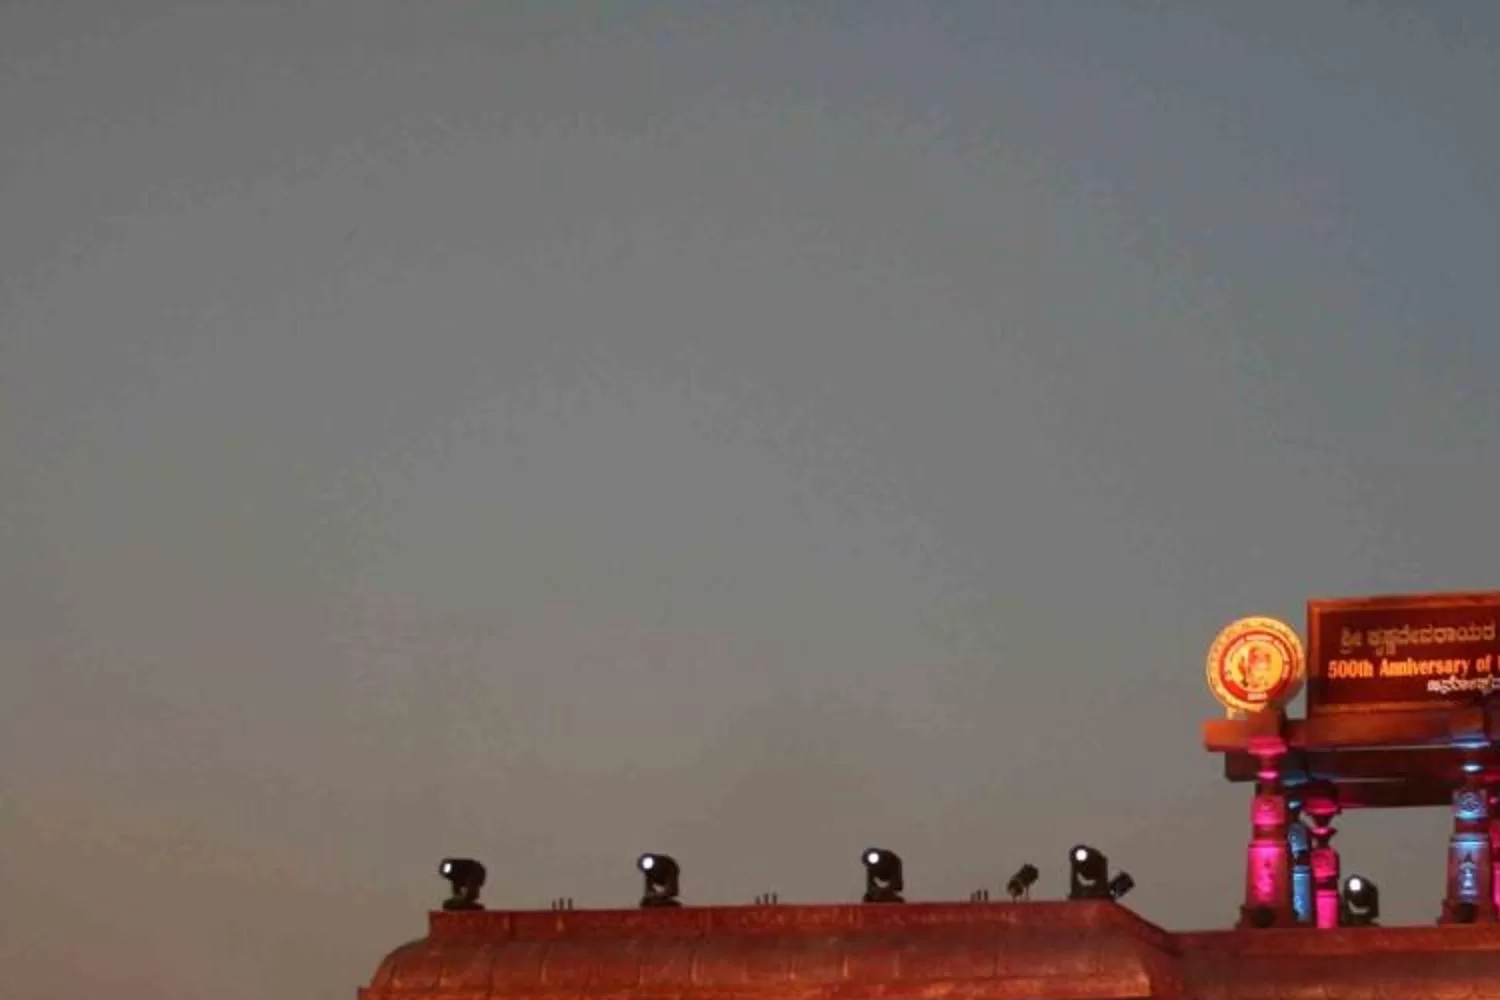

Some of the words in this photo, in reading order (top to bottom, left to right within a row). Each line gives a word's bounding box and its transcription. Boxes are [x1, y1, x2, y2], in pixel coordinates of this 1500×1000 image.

[1328, 659, 1374, 679] 500th
[1379, 657, 1470, 678] Anniversary
[1475, 653, 1493, 673] of
